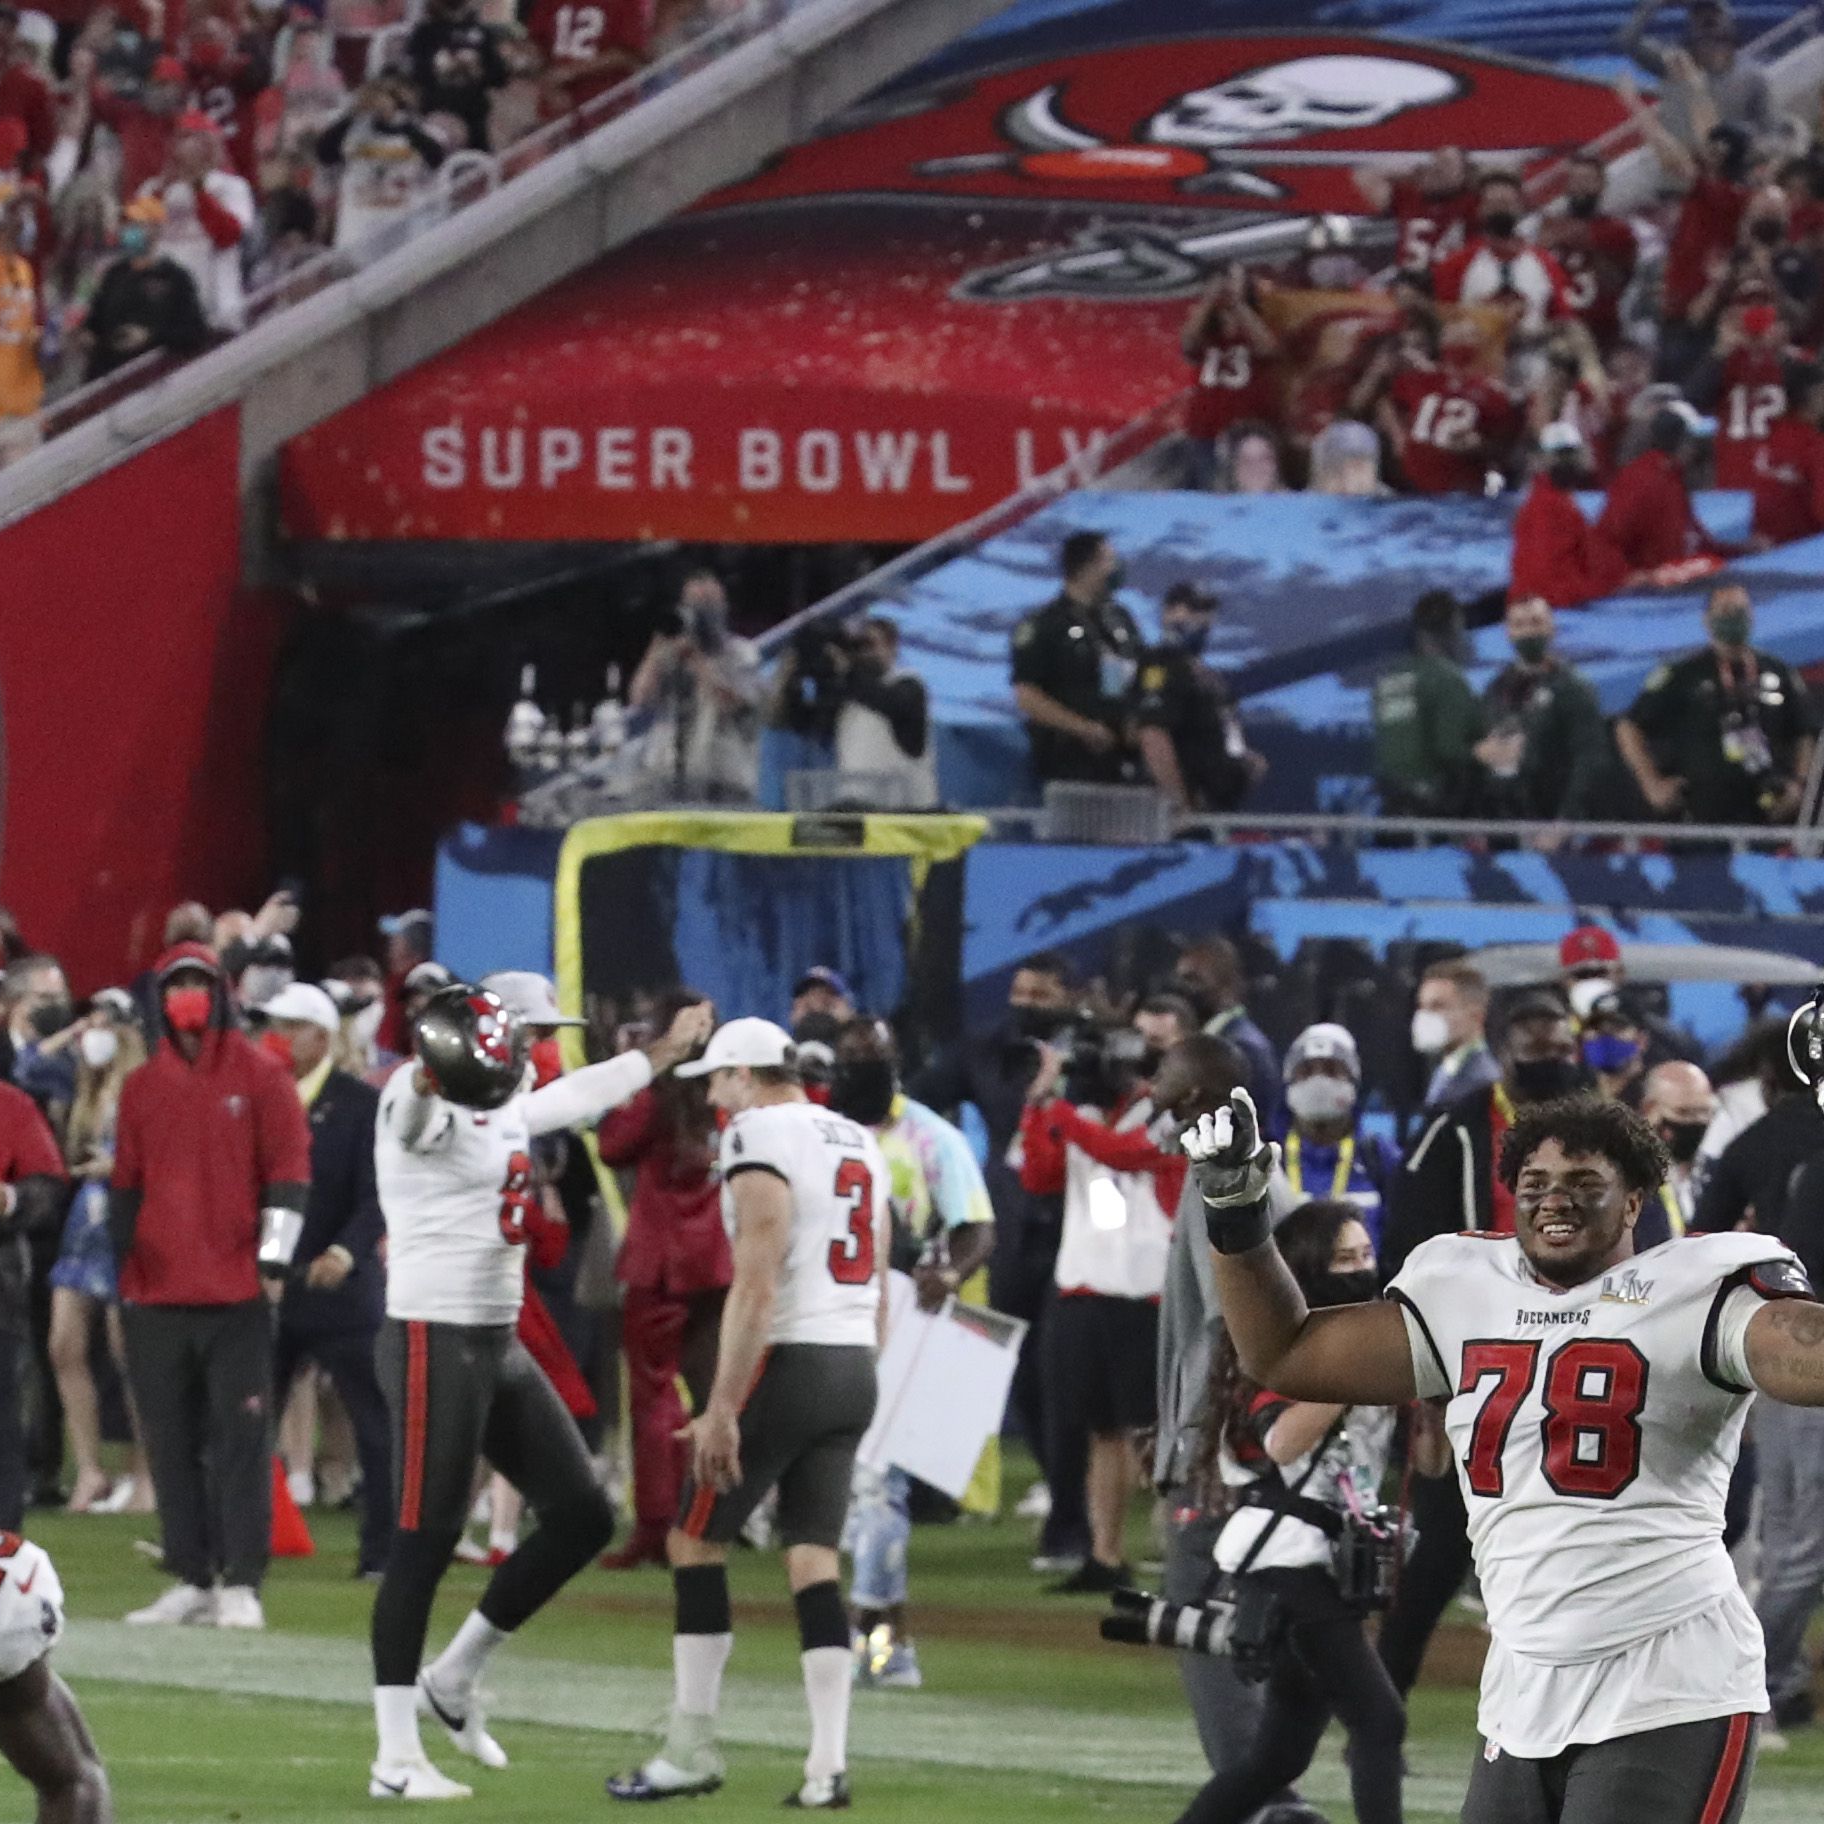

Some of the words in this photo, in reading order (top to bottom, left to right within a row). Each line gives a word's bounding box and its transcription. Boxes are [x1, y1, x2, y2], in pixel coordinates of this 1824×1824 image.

[552, 4, 604, 61] 12
[1199, 345, 1252, 391] 13
[1410, 392, 1478, 449] 12
[1728, 383, 1788, 440] 12
[421, 426, 692, 490] SUPER
[738, 429, 972, 492] BOWL
[826, 1156, 876, 1286] 3
[1515, 1308, 1591, 1327] BUCCANEERS
[1458, 1336, 1651, 1500] 78
